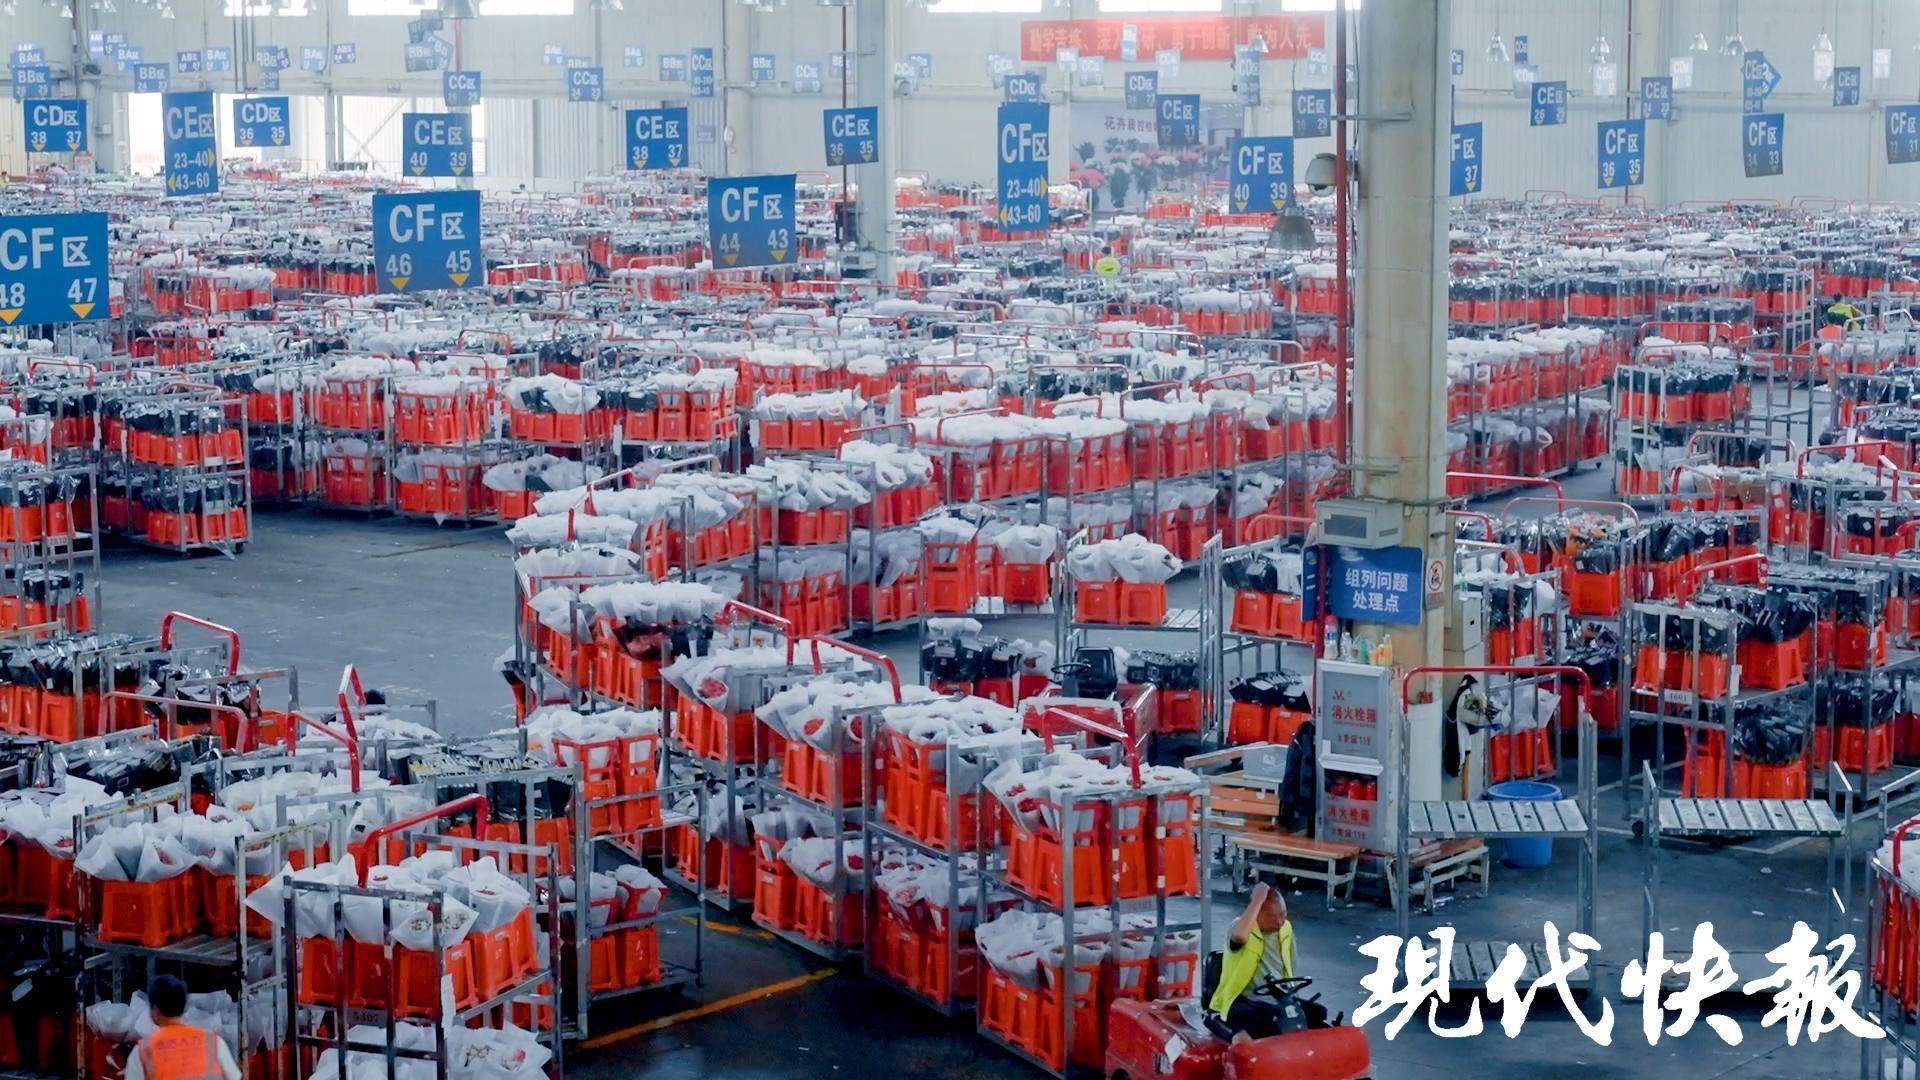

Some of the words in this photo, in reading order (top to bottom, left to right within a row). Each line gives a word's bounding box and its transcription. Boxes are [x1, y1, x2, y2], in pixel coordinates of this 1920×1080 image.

[18, 70, 46, 84] BB区
[448, 74, 476, 90] CC区
[573, 71, 599, 85] CC区
[1009, 78, 1036, 95] CD区
[1129, 75, 1154, 91] CD区
[1537, 86, 1564, 105] CE区
[1645, 81, 1668, 99] CE区
[33, 104, 79, 126] CD区
[241, 102, 282, 124] CD区
[1162, 99, 1193, 121] CE区
[1296, 95, 1326, 114] CE区
[166, 105, 215, 140] CE区
[239, 127, 254, 141] 36
[271, 126, 286, 139] 35
[415, 119, 464, 146] CE区
[635, 115, 680, 140] CE区
[831, 114, 871, 138] CE区
[1890, 111, 1917, 135] CF区
[31, 131, 47, 144] 38
[66, 130, 82, 144] 37
[1002, 122, 1049, 164] CF区
[1605, 128, 1639, 154] CF区
[1748, 121, 1778, 147] CF区
[632, 146, 649, 161] 38
[667, 144, 683, 159] 37
[830, 143, 844, 157] 36
[859, 140, 874, 155] 35
[1451, 133, 1476, 161] F区
[174, 151, 208, 169] 23-40
[409, 151, 428, 167] 40
[449, 151, 467, 166] 39
[1238, 146, 1284, 176] CF区
[1602, 161, 1615, 178] 36
[1628, 159, 1641, 176] 35
[1768, 151, 1780, 166] 33
[175, 172, 210, 190] 43-60
[1464, 165, 1478, 182] 37
[1006, 177, 1041, 199] 23-40
[1234, 183, 1249, 201] 40
[1269, 181, 1288, 200] 39
[721, 186, 783, 223] CF区
[1007, 204, 1041, 225] 43-60
[389, 203, 465, 244] CF区
[0, 227, 91, 272] CF区
[719, 232, 741, 253] 44
[767, 228, 789, 249] 43
[385, 253, 413, 276] 46
[445, 249, 472, 272] 45
[67, 277, 98, 303] 47
[1345, 567, 1409, 593] 组列问题
[1352, 590, 1400, 613] 处理点
[1332, 704, 1377, 723] 消火栓箱
